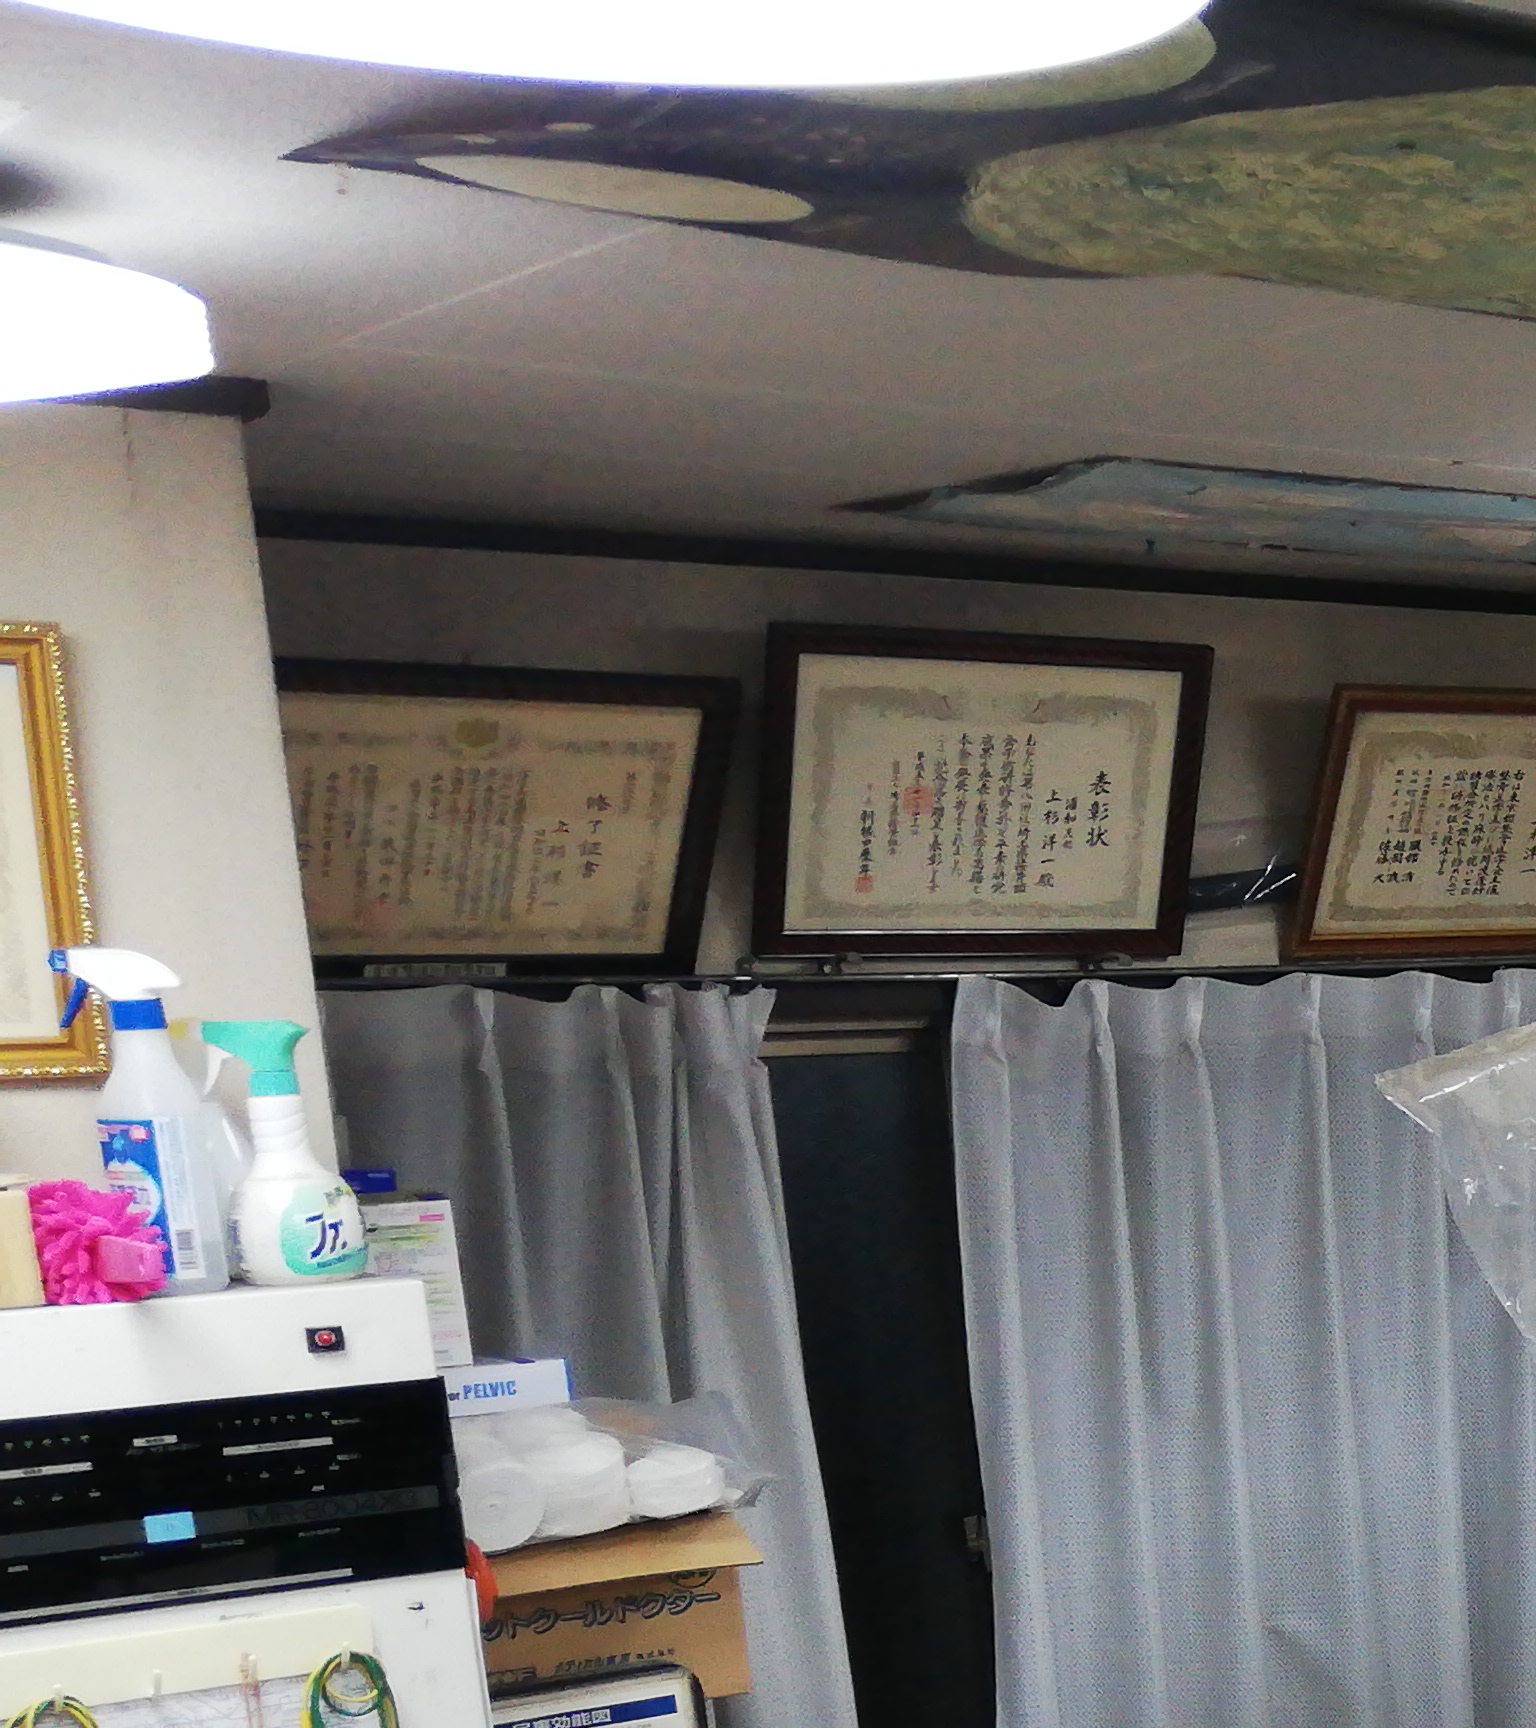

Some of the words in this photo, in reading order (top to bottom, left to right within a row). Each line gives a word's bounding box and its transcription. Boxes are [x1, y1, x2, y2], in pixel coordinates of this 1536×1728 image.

[1085, 769, 1112, 848] 表彰状
[462, 1380, 518, 1400] PELVIC
